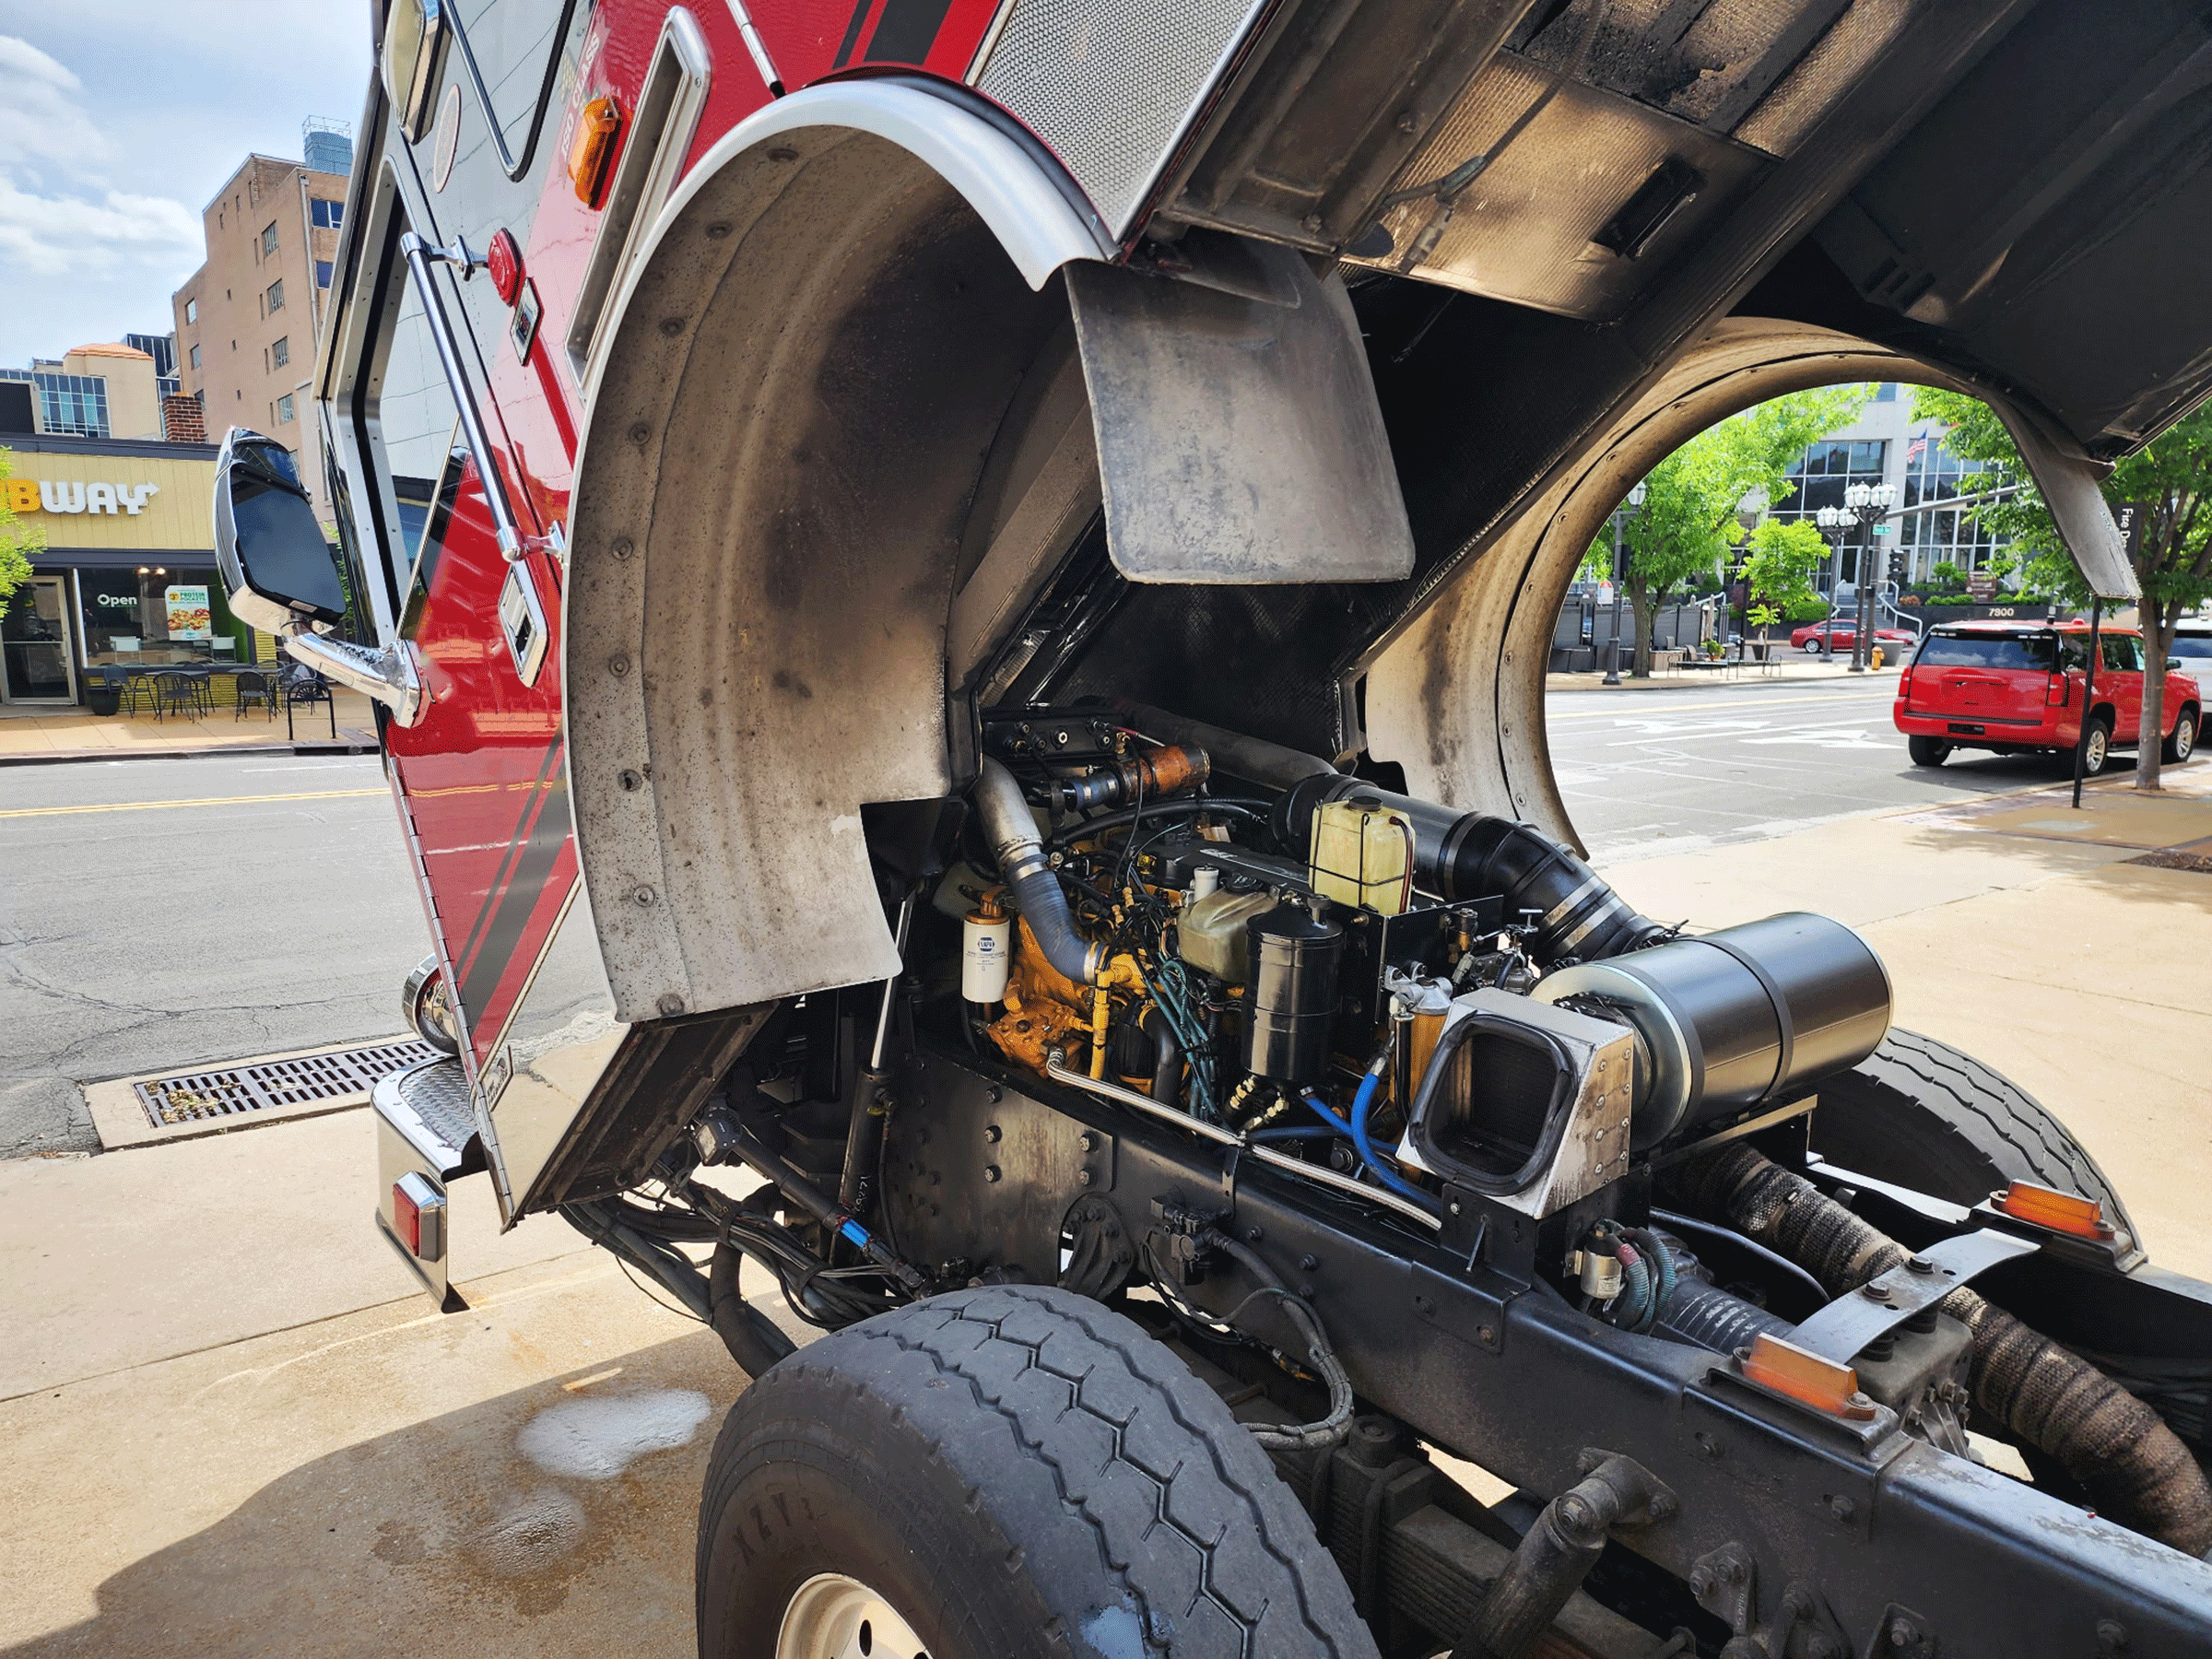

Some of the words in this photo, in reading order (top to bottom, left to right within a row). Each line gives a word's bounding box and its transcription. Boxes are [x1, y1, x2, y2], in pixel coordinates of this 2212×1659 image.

[572, 32, 600, 110] CLASS
[0, 478, 160, 515] BWAY
[2120, 508, 2134, 529] Fire
[97, 594, 138, 607] Open
[1988, 607, 2015, 618] 7800
